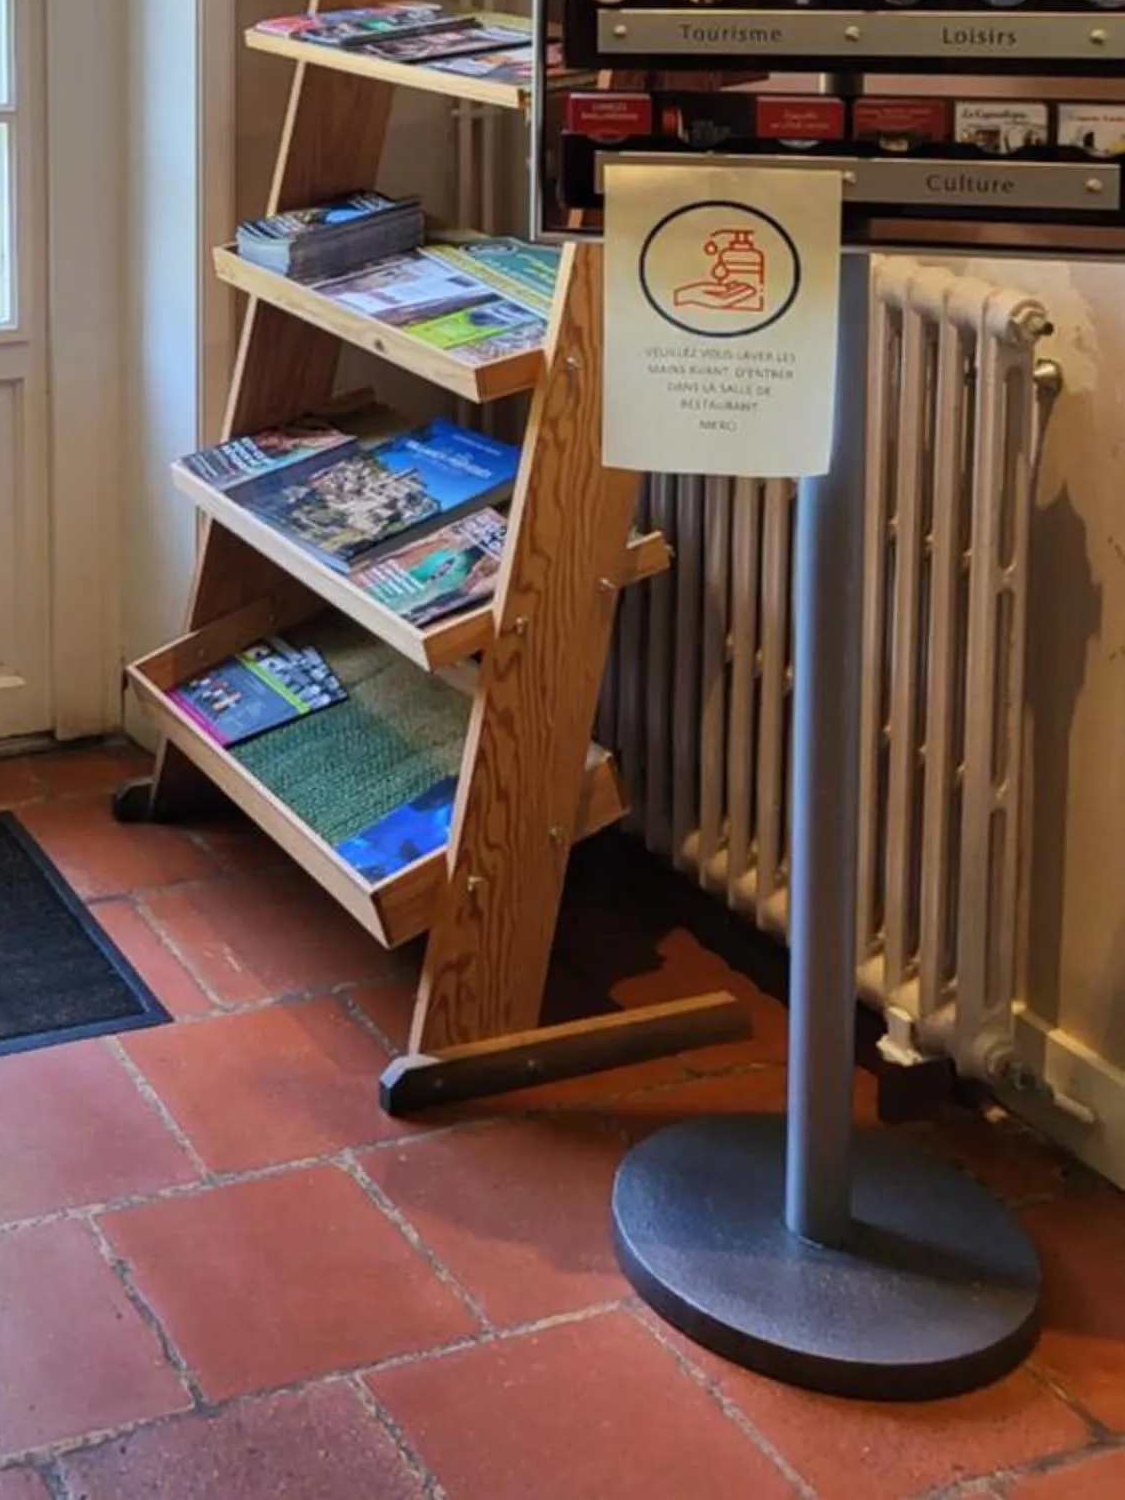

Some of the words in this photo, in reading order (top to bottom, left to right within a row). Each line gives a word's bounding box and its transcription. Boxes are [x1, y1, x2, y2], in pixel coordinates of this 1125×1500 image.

[679, 23, 783, 44] Tourisme
[942, 27, 1017, 48] Loisirs
[926, 174, 1015, 196] Culture
